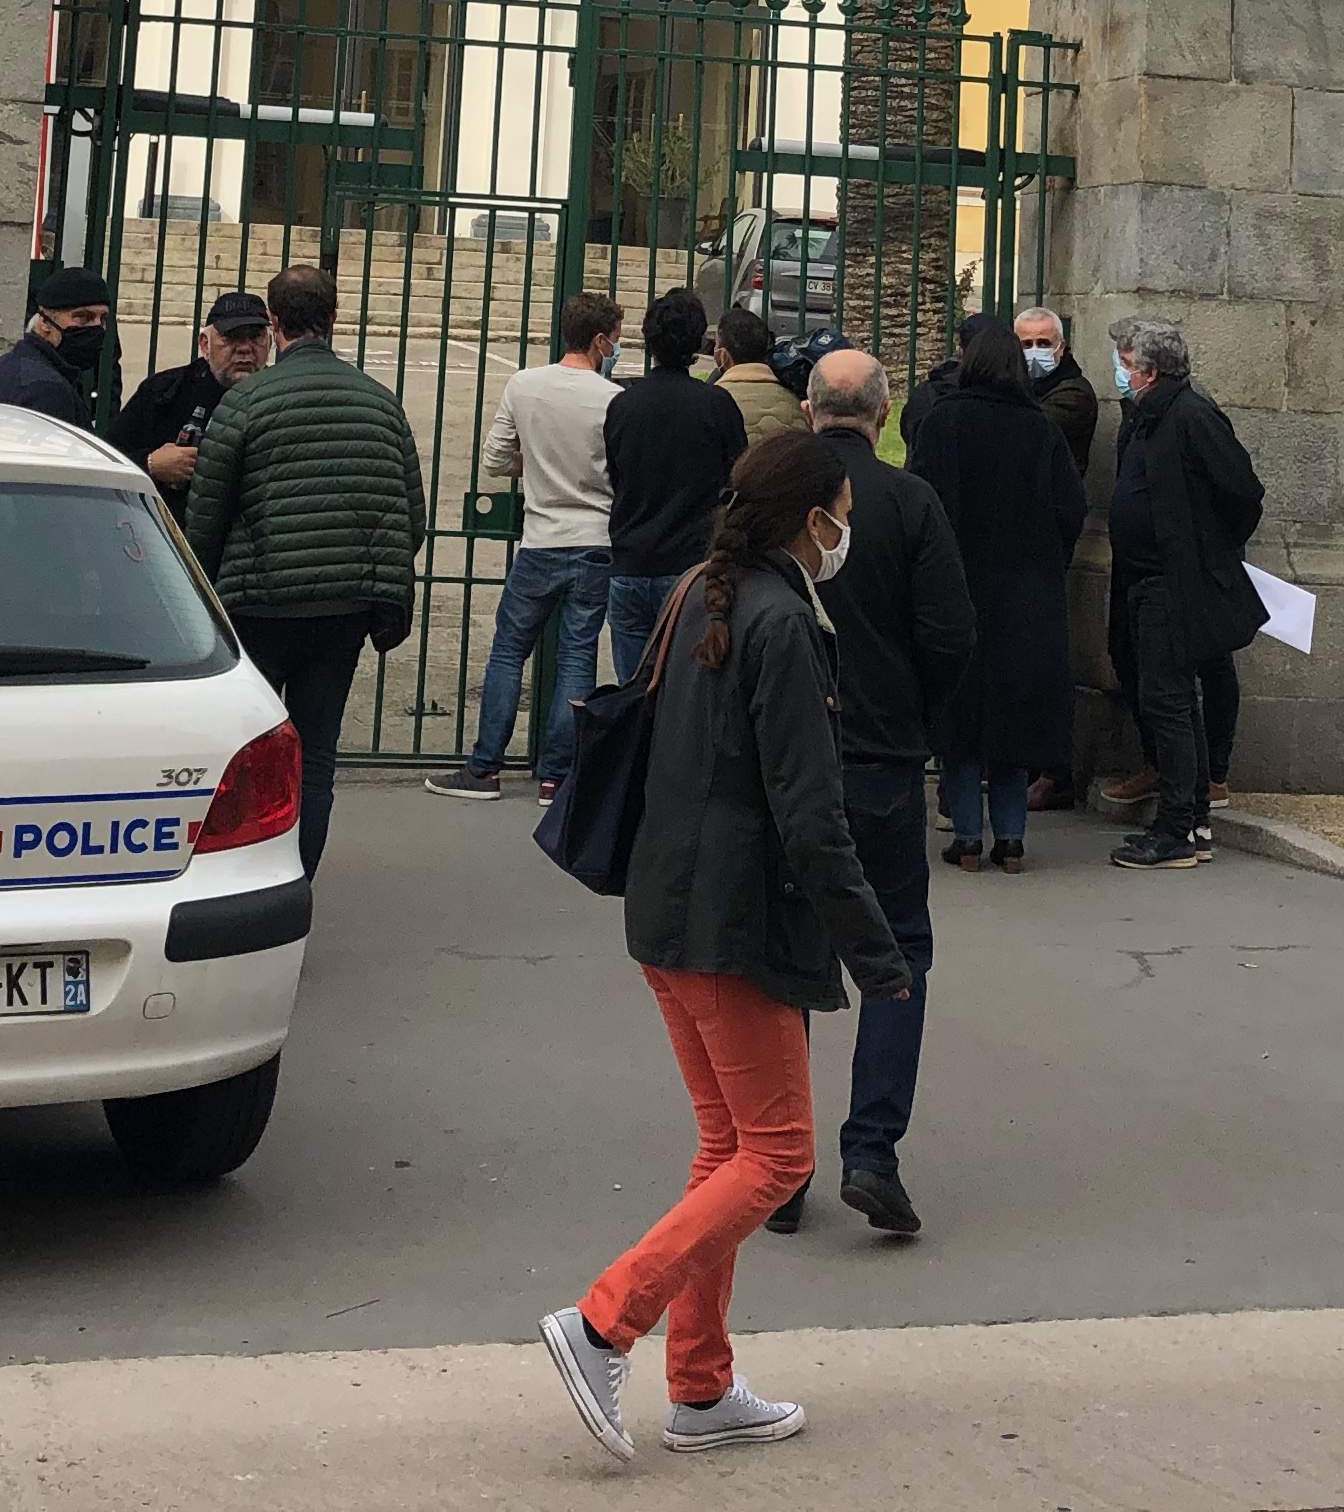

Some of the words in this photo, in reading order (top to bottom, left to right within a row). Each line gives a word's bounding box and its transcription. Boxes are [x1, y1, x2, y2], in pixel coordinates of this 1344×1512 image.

[156, 767, 208, 787] 307
[13, 817, 181, 858] POLICE
[64, 983, 87, 1007] 2A
